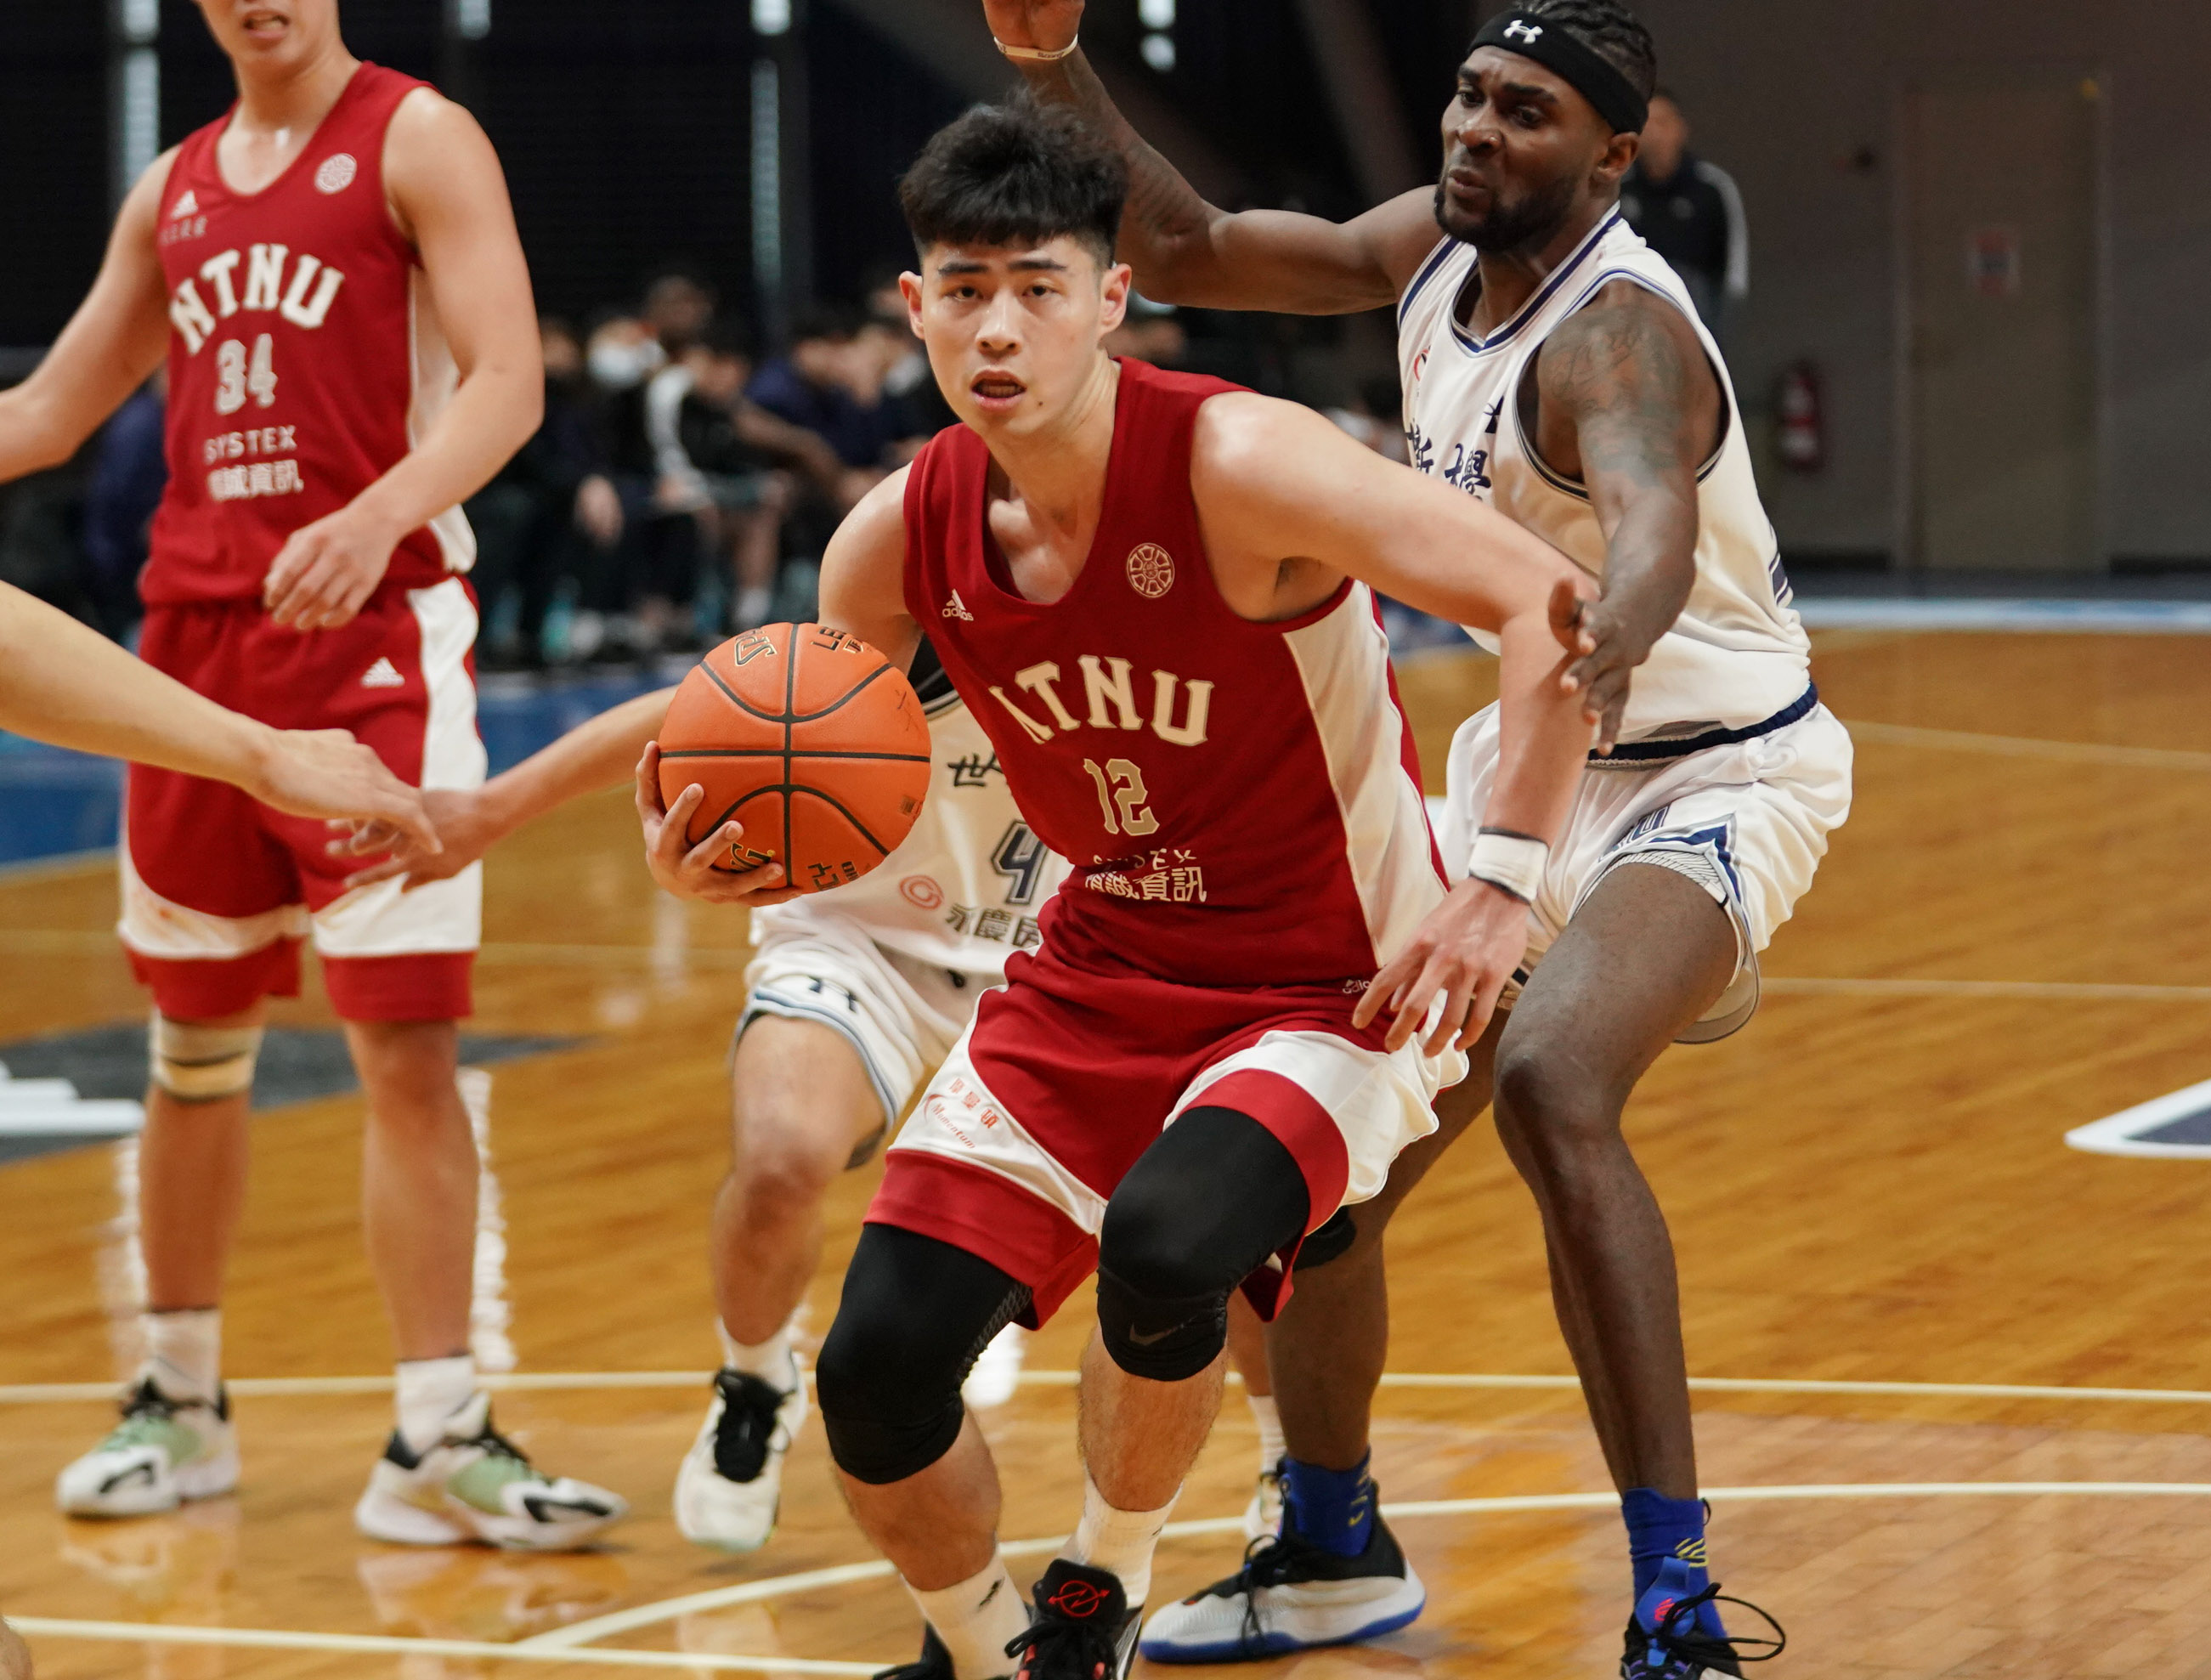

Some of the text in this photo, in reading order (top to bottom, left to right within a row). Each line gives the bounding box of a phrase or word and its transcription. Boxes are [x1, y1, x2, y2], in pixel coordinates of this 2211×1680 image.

[170, 243, 344, 354] NTNU
[216, 332, 277, 415] 34
[204, 425, 297, 465] SYSTEX
[1083, 758, 1160, 837] 12
[991, 819, 1050, 905] 4
